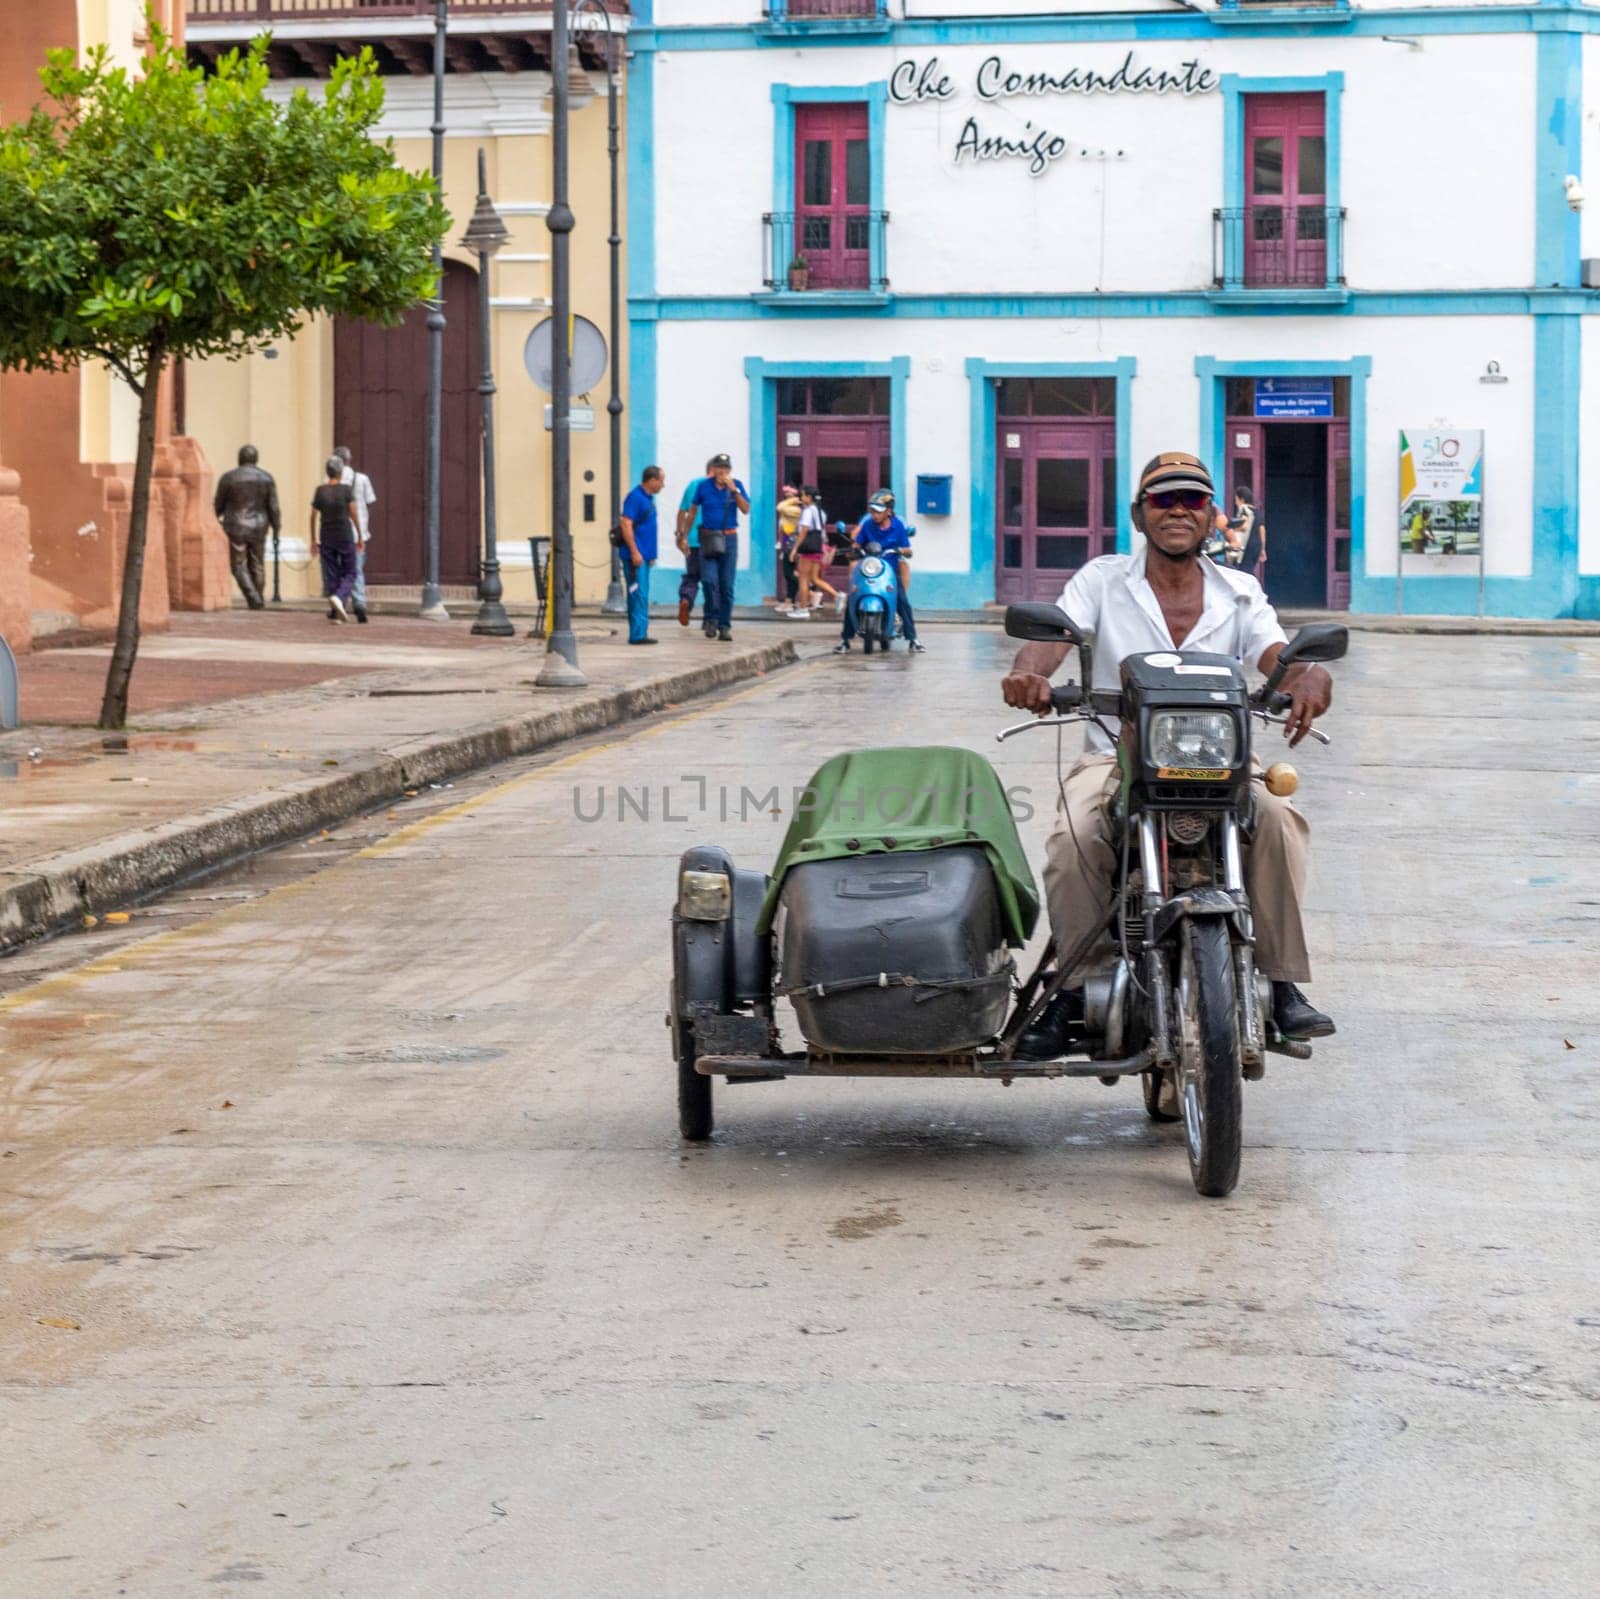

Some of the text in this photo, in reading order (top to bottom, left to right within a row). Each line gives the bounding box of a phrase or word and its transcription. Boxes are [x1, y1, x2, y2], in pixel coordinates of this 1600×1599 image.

[890, 51, 1218, 101] Che Comandante
[954, 116, 1066, 175] Amigo
